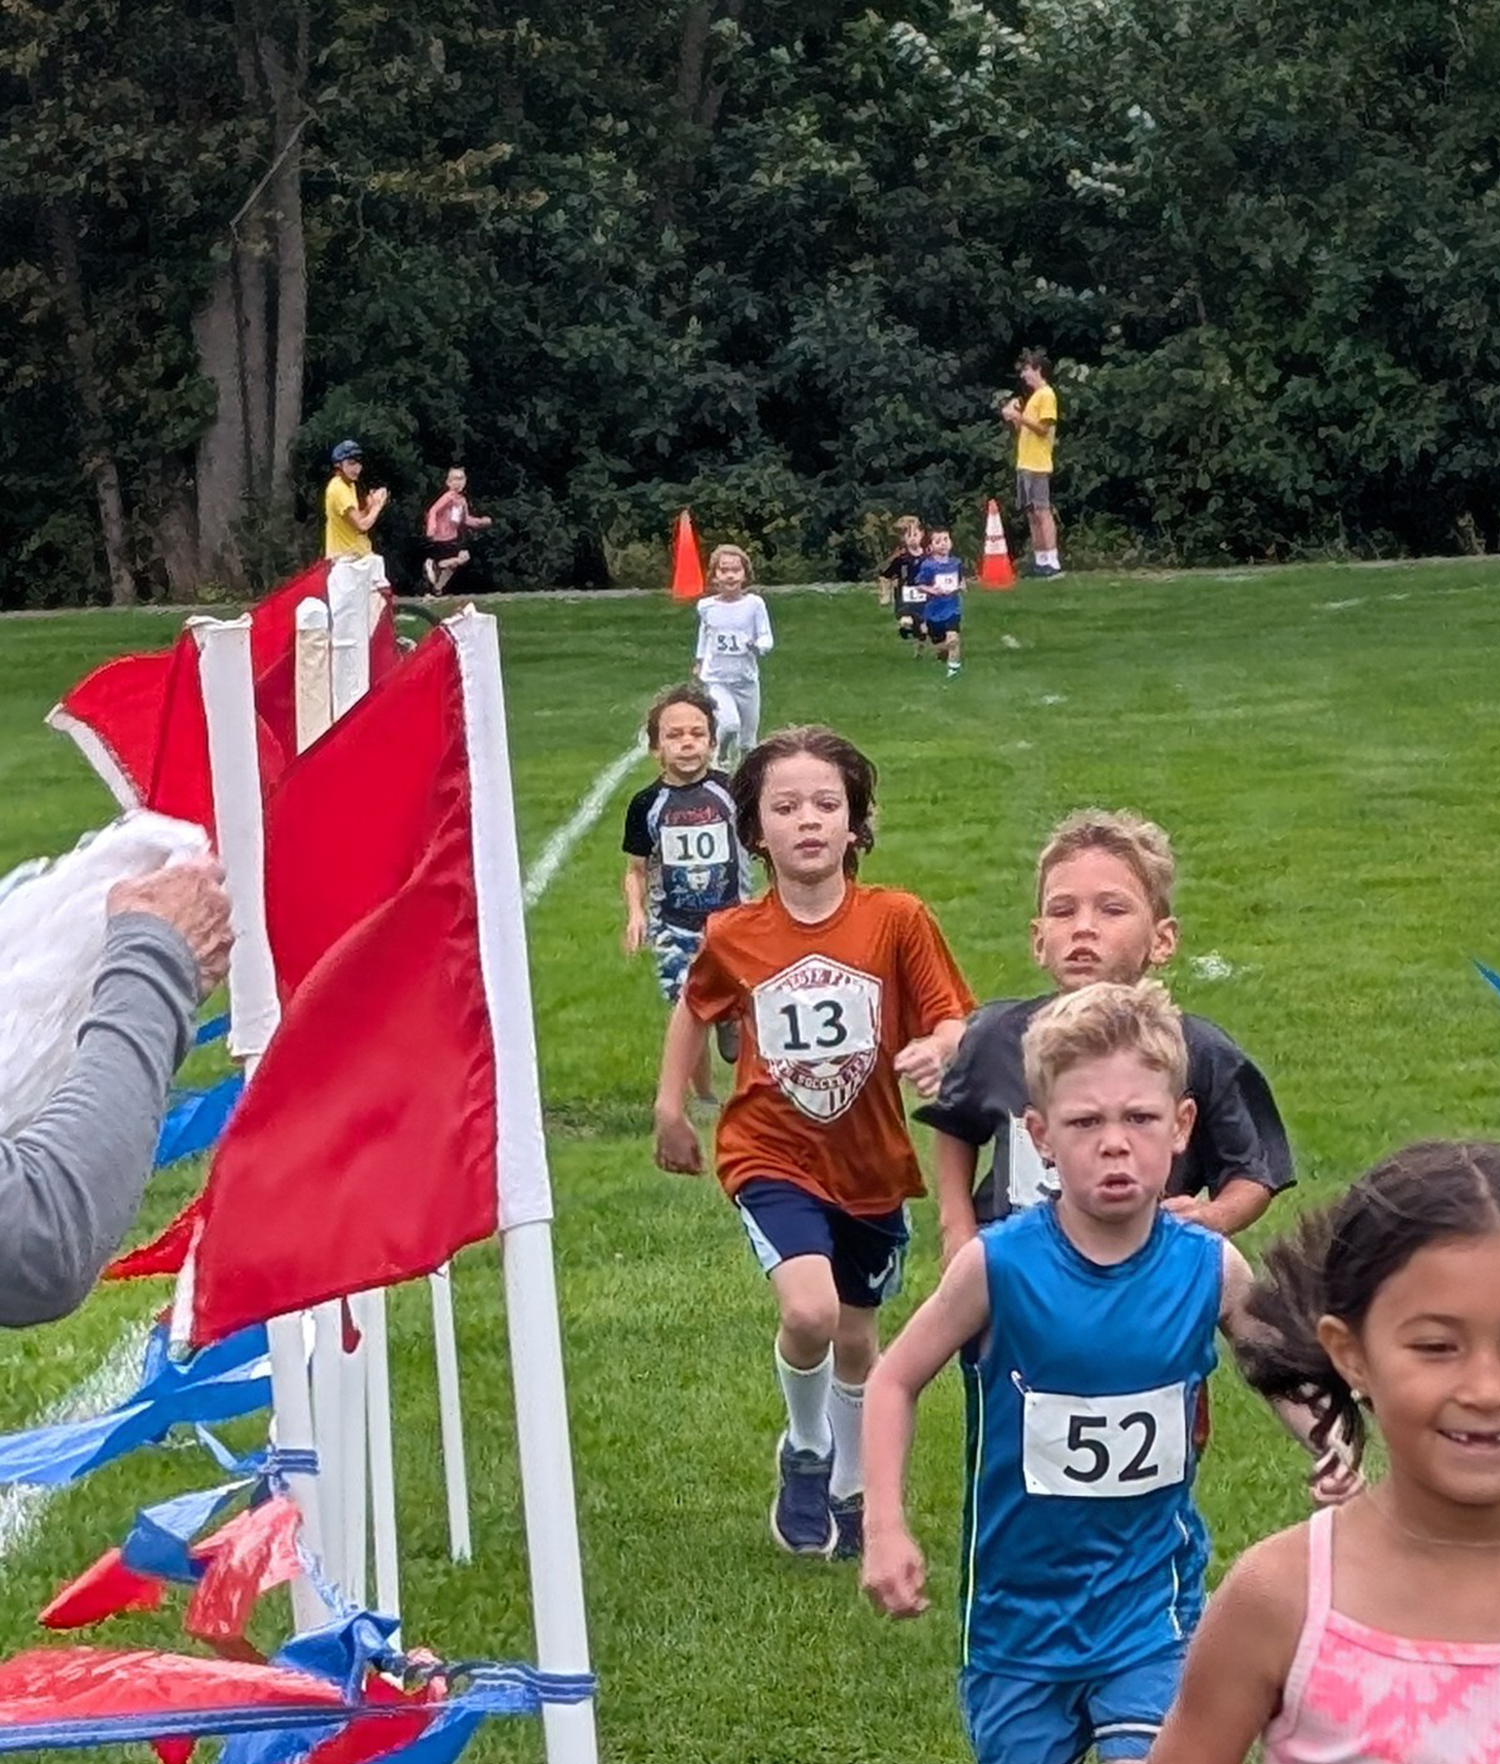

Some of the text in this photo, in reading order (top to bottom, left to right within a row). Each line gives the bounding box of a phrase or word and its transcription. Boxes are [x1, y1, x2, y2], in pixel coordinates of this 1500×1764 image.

[676, 832, 715, 860] 10
[780, 1000, 848, 1051] 13
[797, 1075, 845, 1090] SOCCER
[1063, 1411, 1159, 1483] 52
